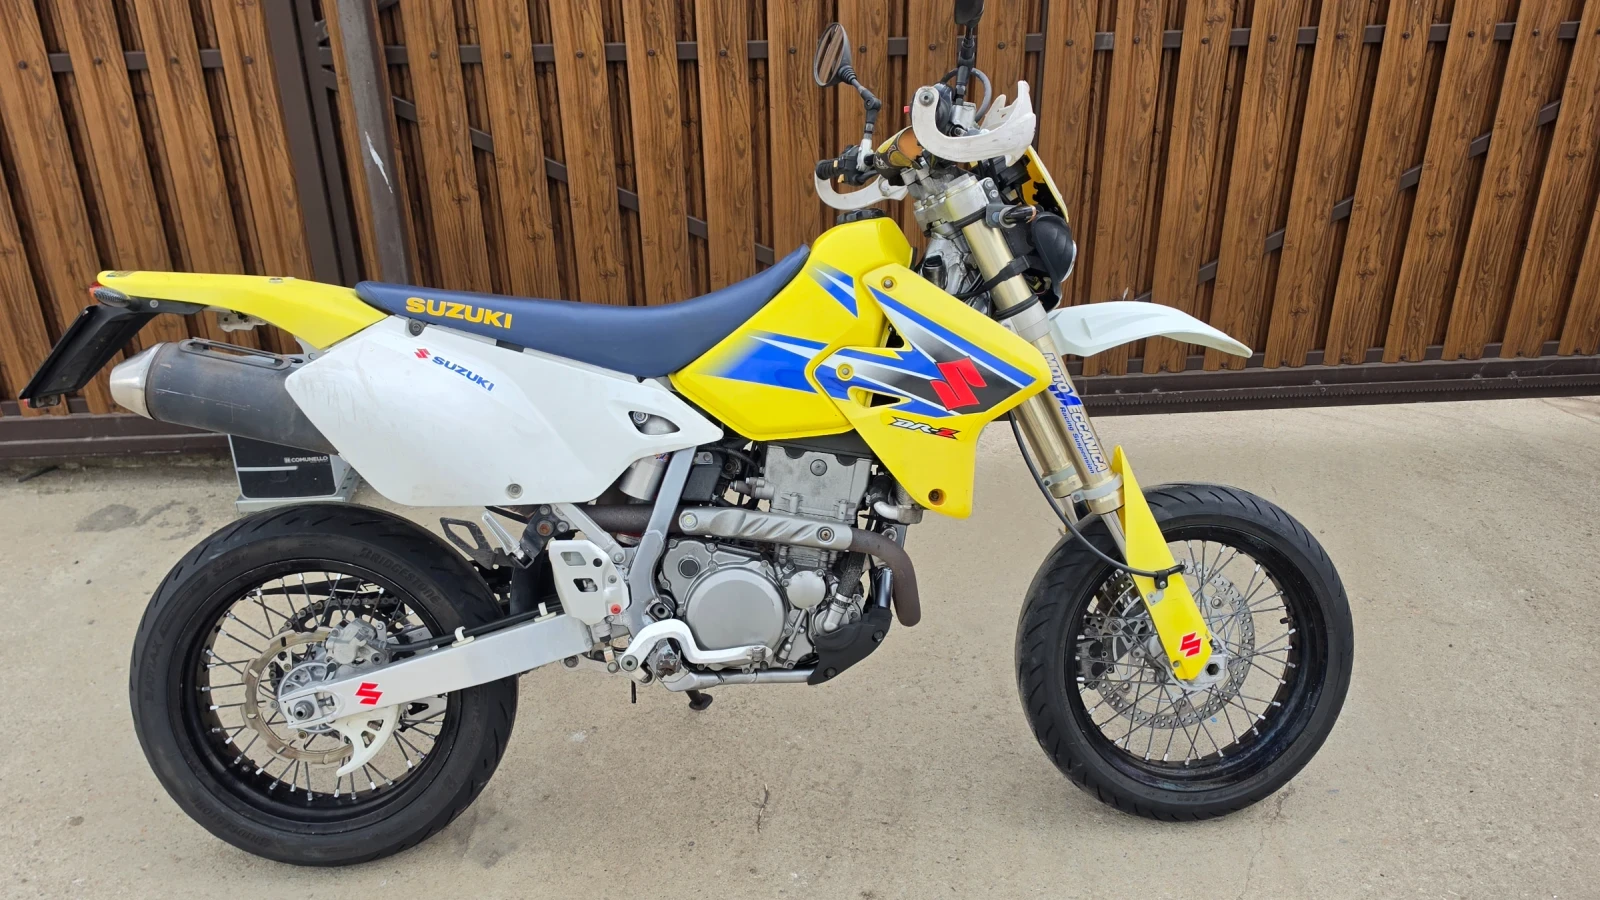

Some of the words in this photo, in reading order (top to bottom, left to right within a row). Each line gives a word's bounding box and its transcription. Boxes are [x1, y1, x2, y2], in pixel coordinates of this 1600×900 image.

[405, 297, 513, 329] SUZUKI
[432, 355, 495, 391] SUZUKI
[1059, 406, 1075, 431] Racing
[1072, 433, 1096, 474] Suspension
[291, 455, 329, 463] COMUNELLO
